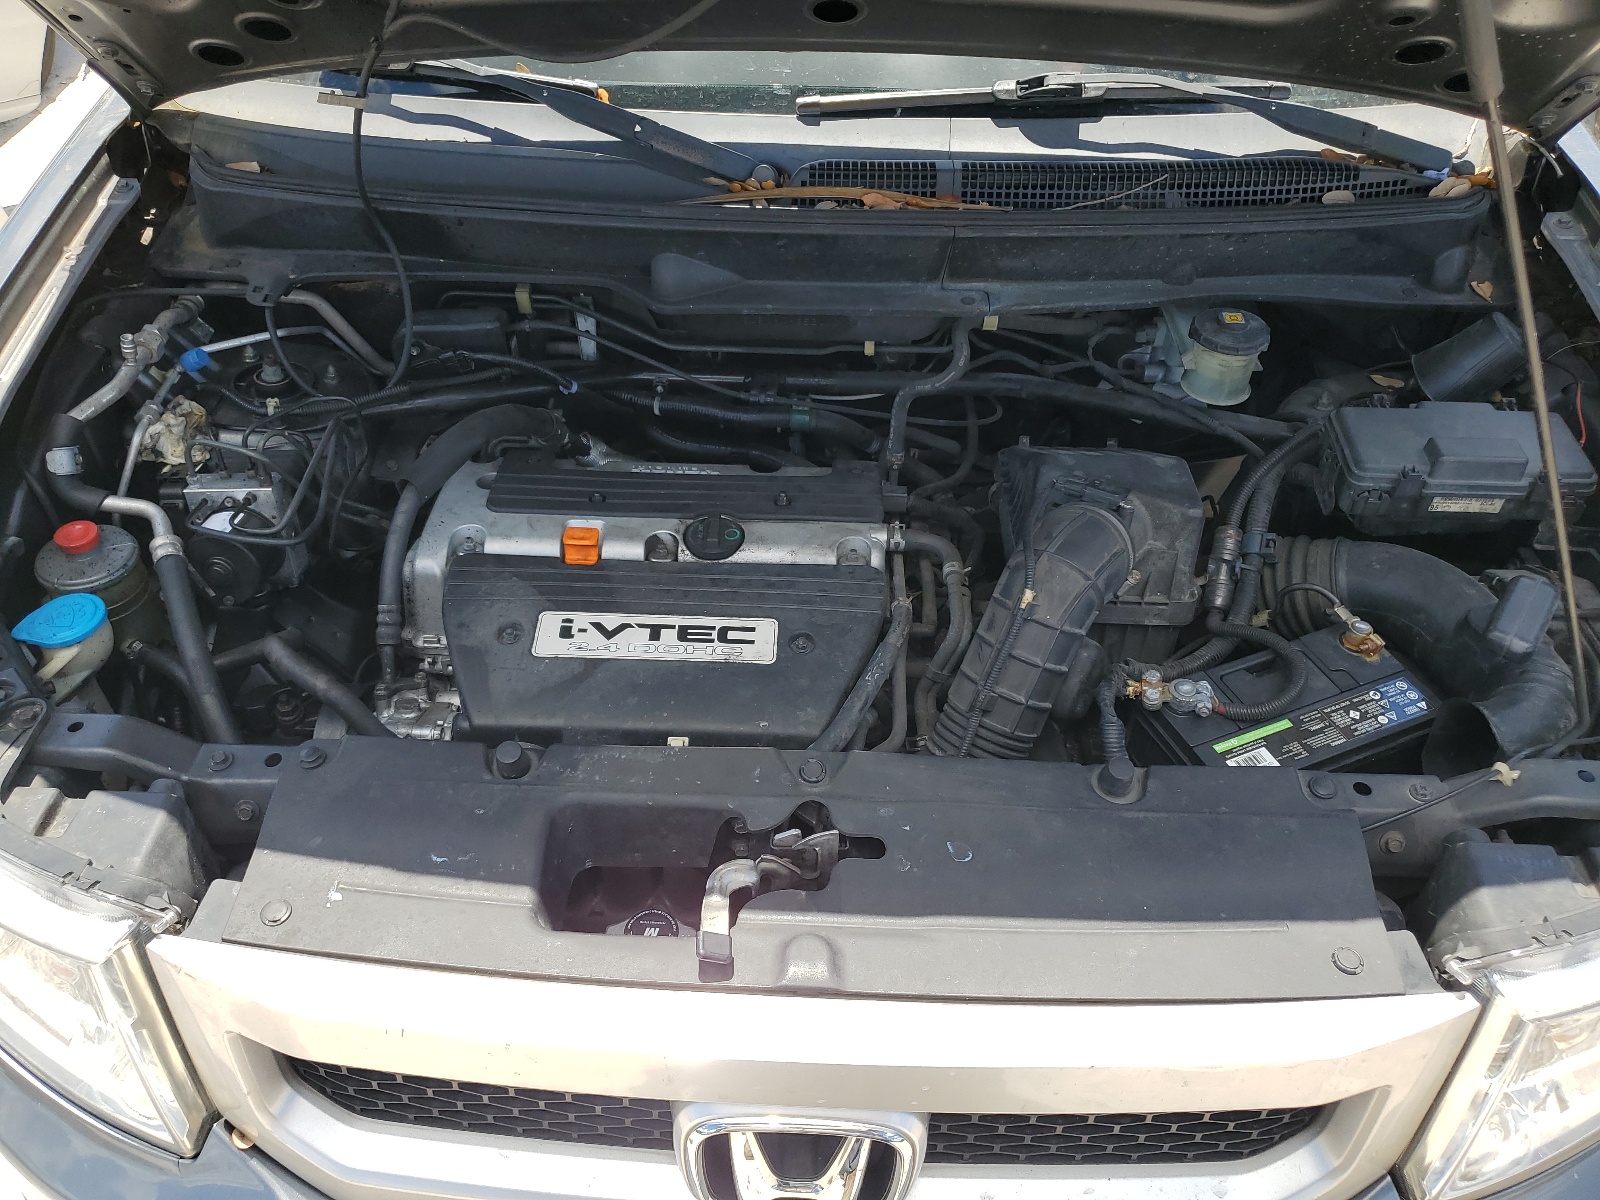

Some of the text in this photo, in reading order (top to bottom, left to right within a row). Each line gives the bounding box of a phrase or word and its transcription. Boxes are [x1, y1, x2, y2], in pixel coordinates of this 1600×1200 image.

[558, 618, 756, 645] i-VTEC
[567, 642, 743, 656] 2.4 DOHC
